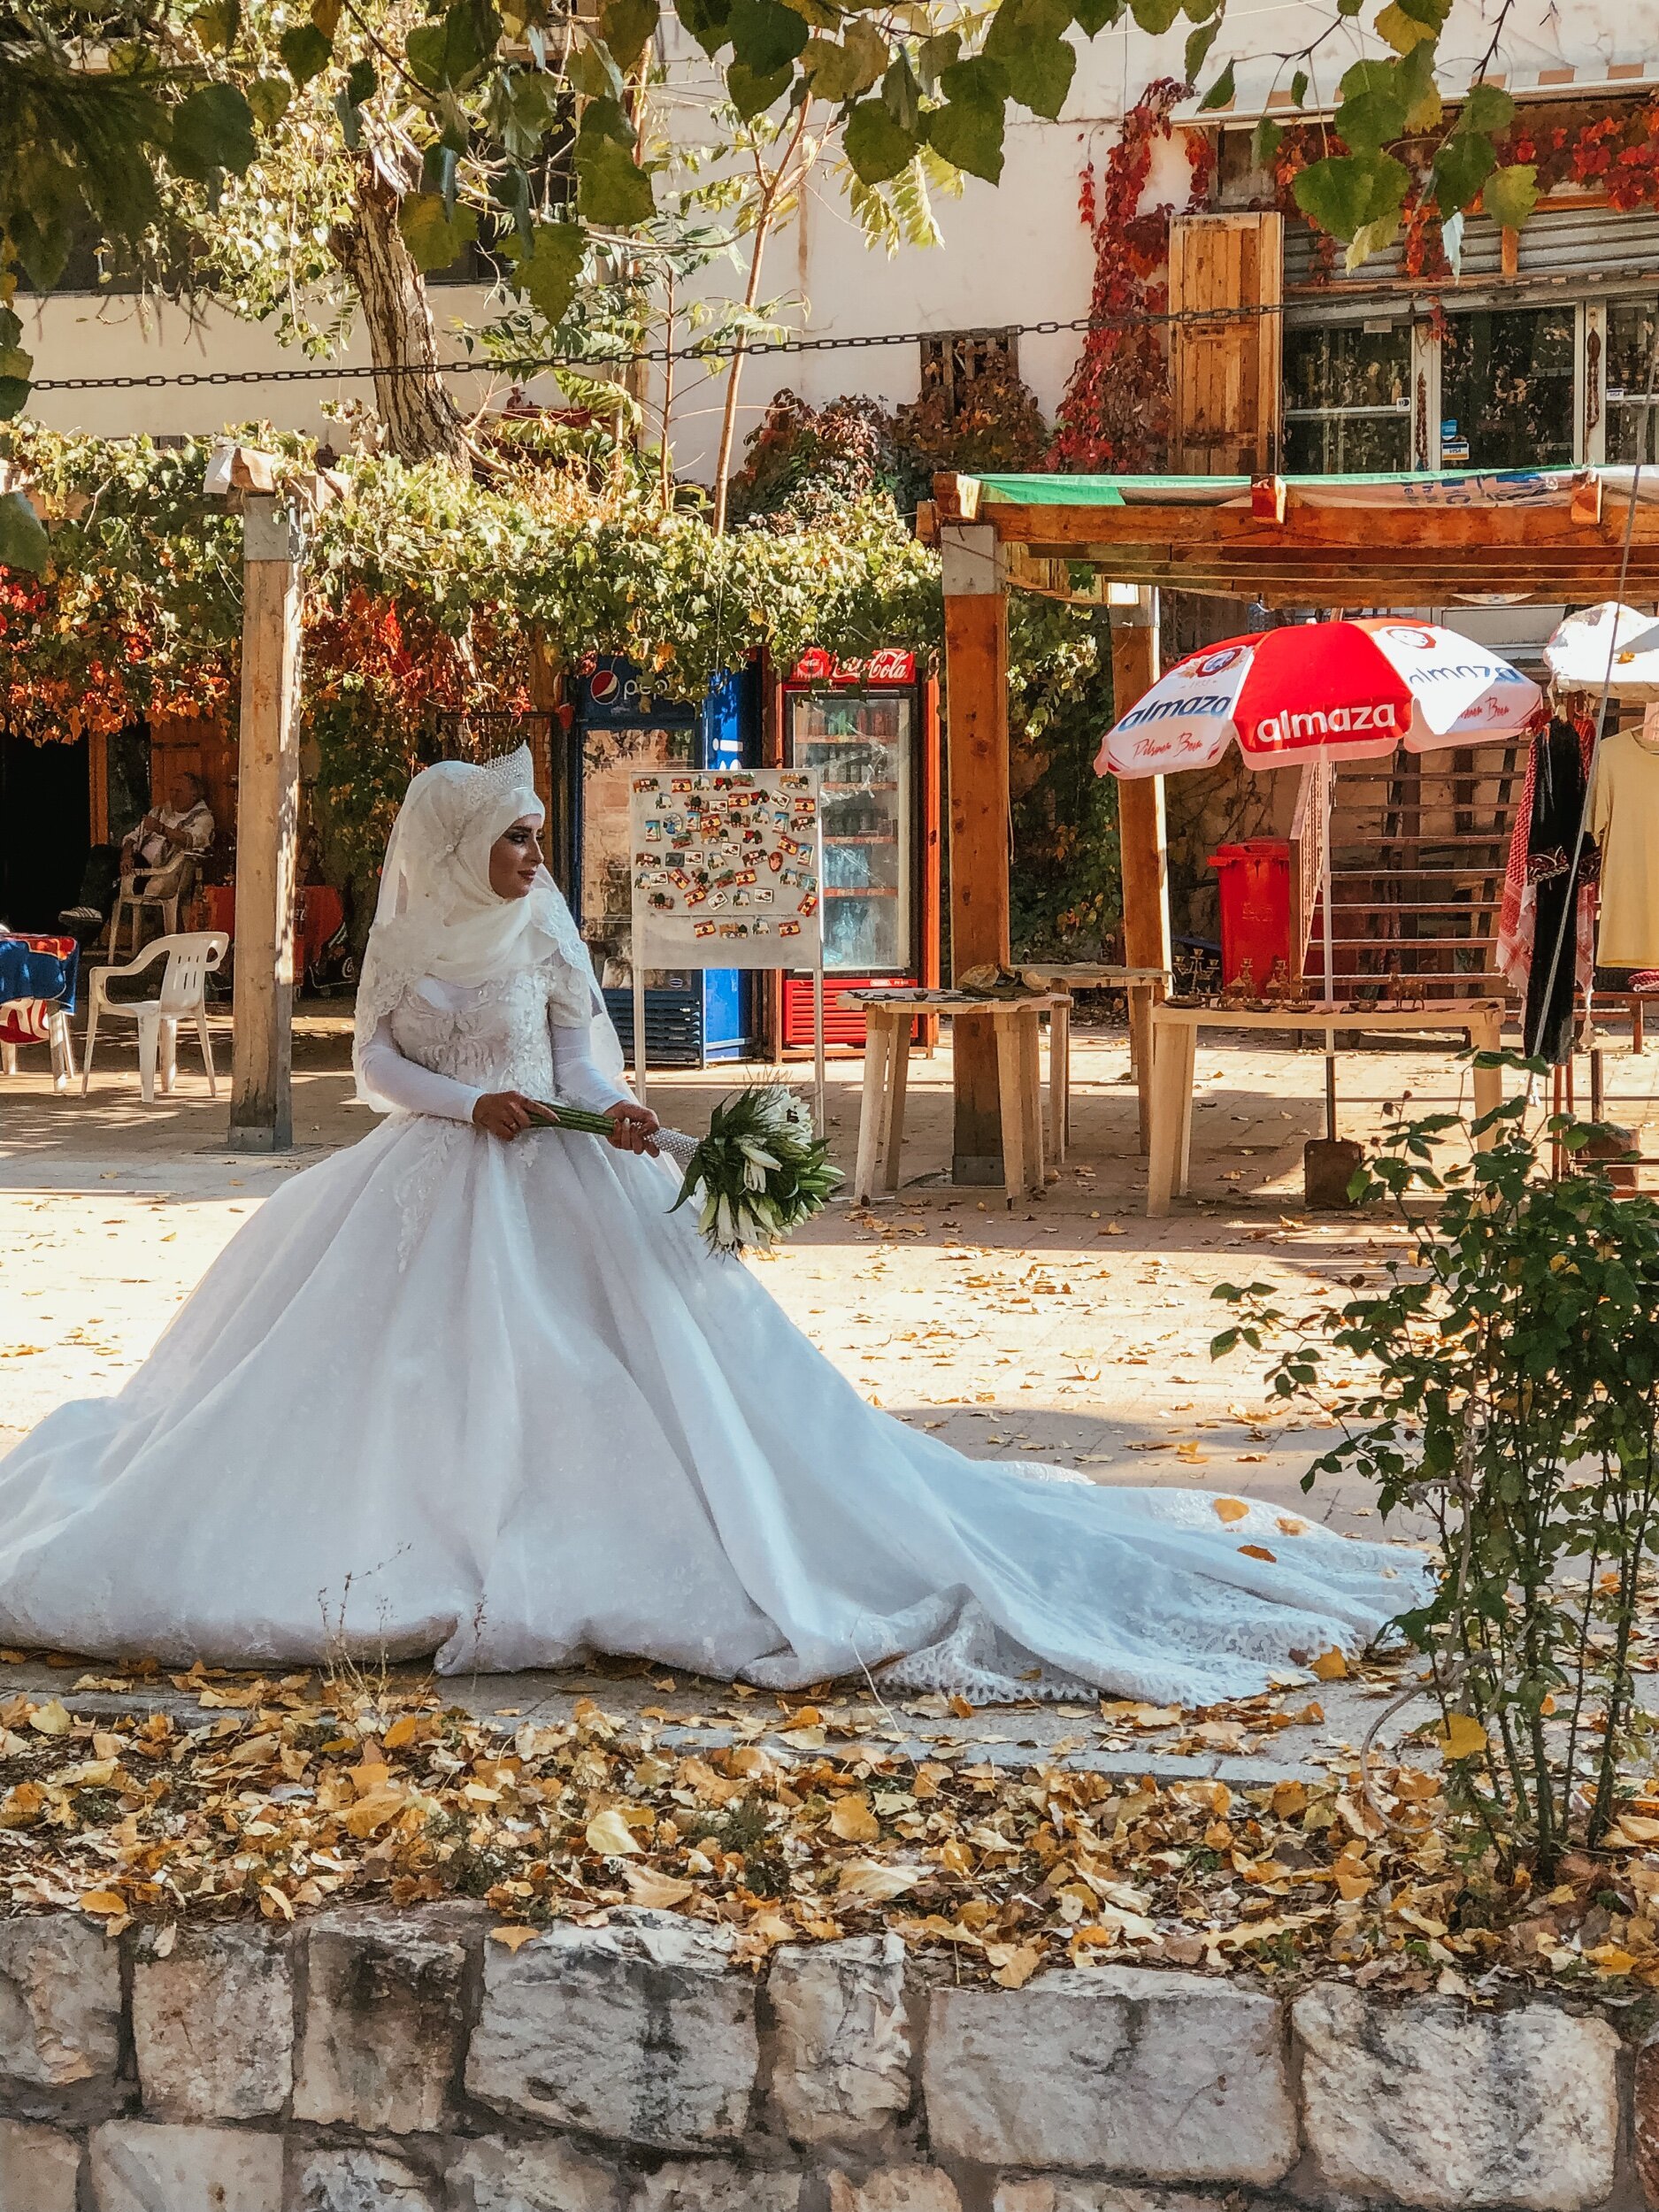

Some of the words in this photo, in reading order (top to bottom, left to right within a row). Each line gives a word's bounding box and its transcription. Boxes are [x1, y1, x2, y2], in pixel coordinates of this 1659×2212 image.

[1118, 695, 1233, 733] almaza
[1256, 703, 1395, 743] almaza
[1173, 732, 1203, 758] Beer
